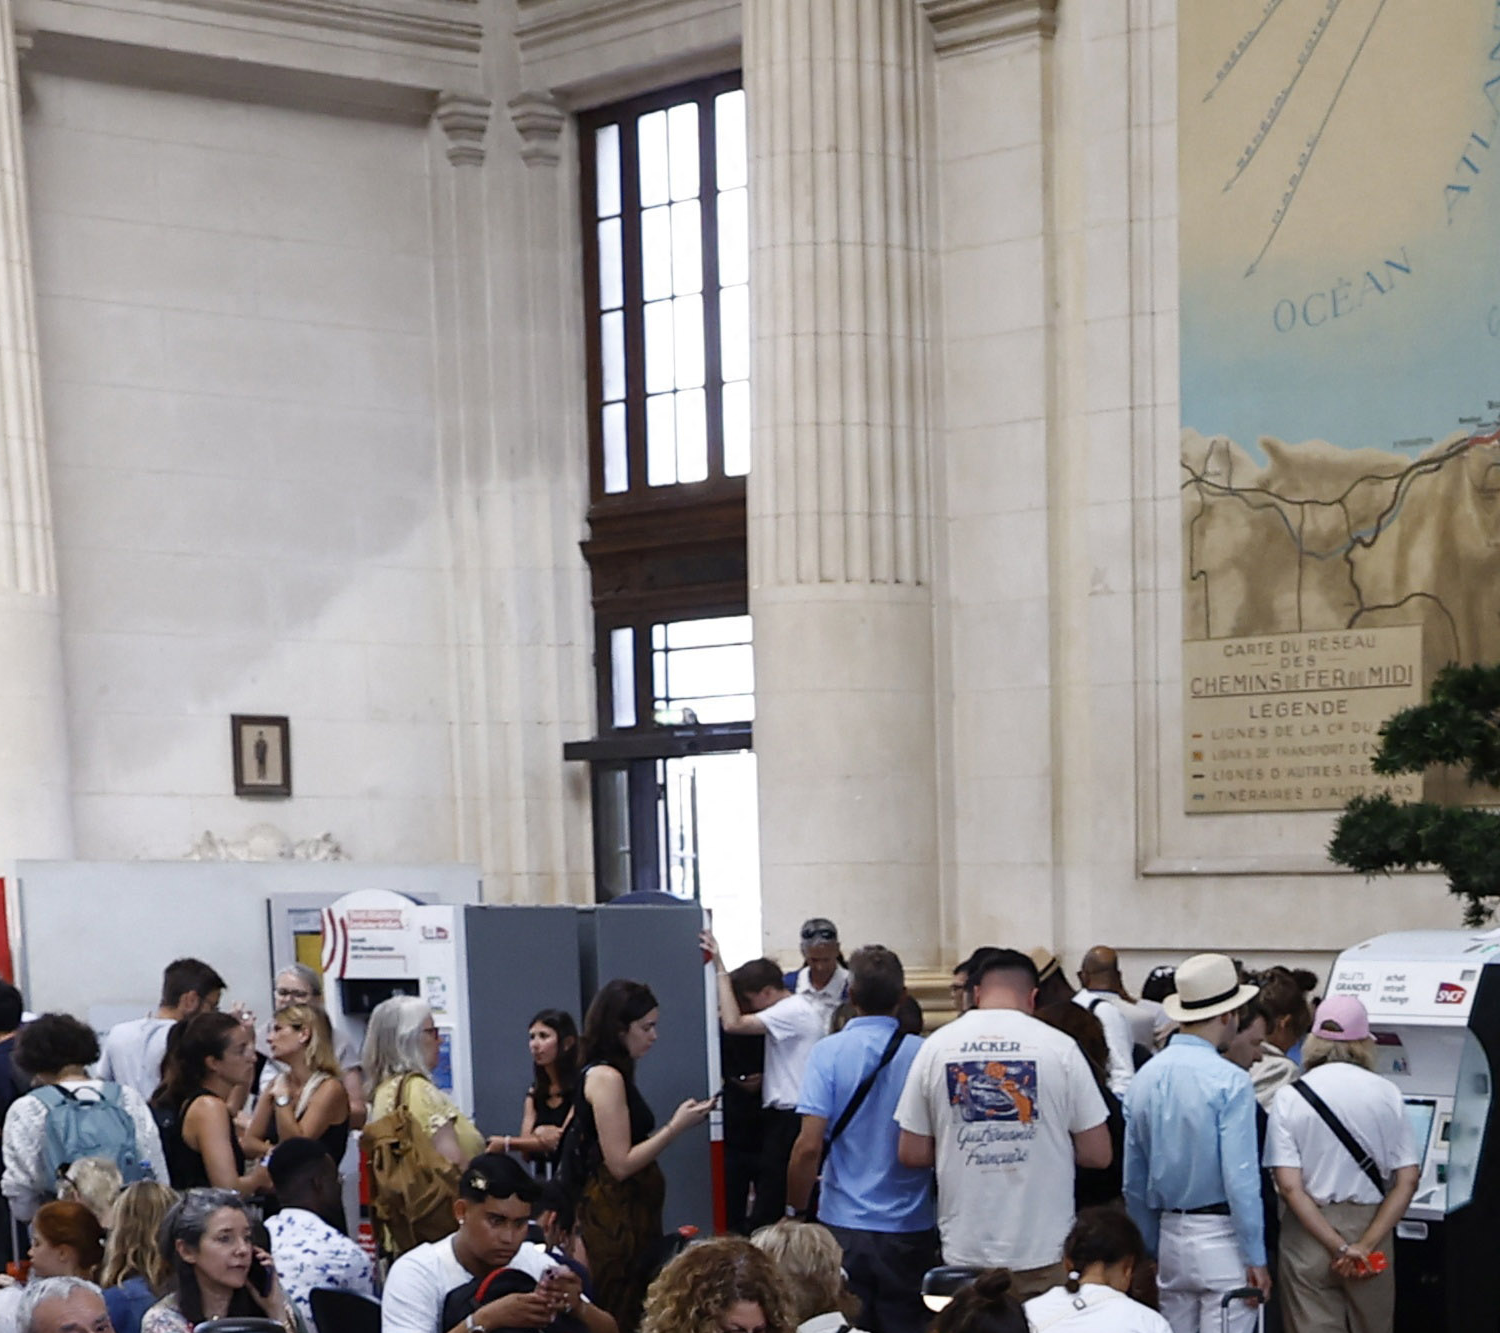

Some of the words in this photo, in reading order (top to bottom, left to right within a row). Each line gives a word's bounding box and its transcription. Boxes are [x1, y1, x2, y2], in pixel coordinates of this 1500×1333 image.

[1273, 247, 1413, 334] OCÉAN
[1223, 641, 1274, 658] CARTE
[1281, 640, 1301, 654] DU
[1281, 655, 1317, 669] DES
[1190, 673, 1282, 696] CHEMINS
[1304, 668, 1347, 689] FER
[1368, 665, 1413, 685] MIDI
[1383, 983, 1407, 994] retrait
[1436, 990, 1465, 1004] SNCF
[959, 1041, 1022, 1053] JACKER
